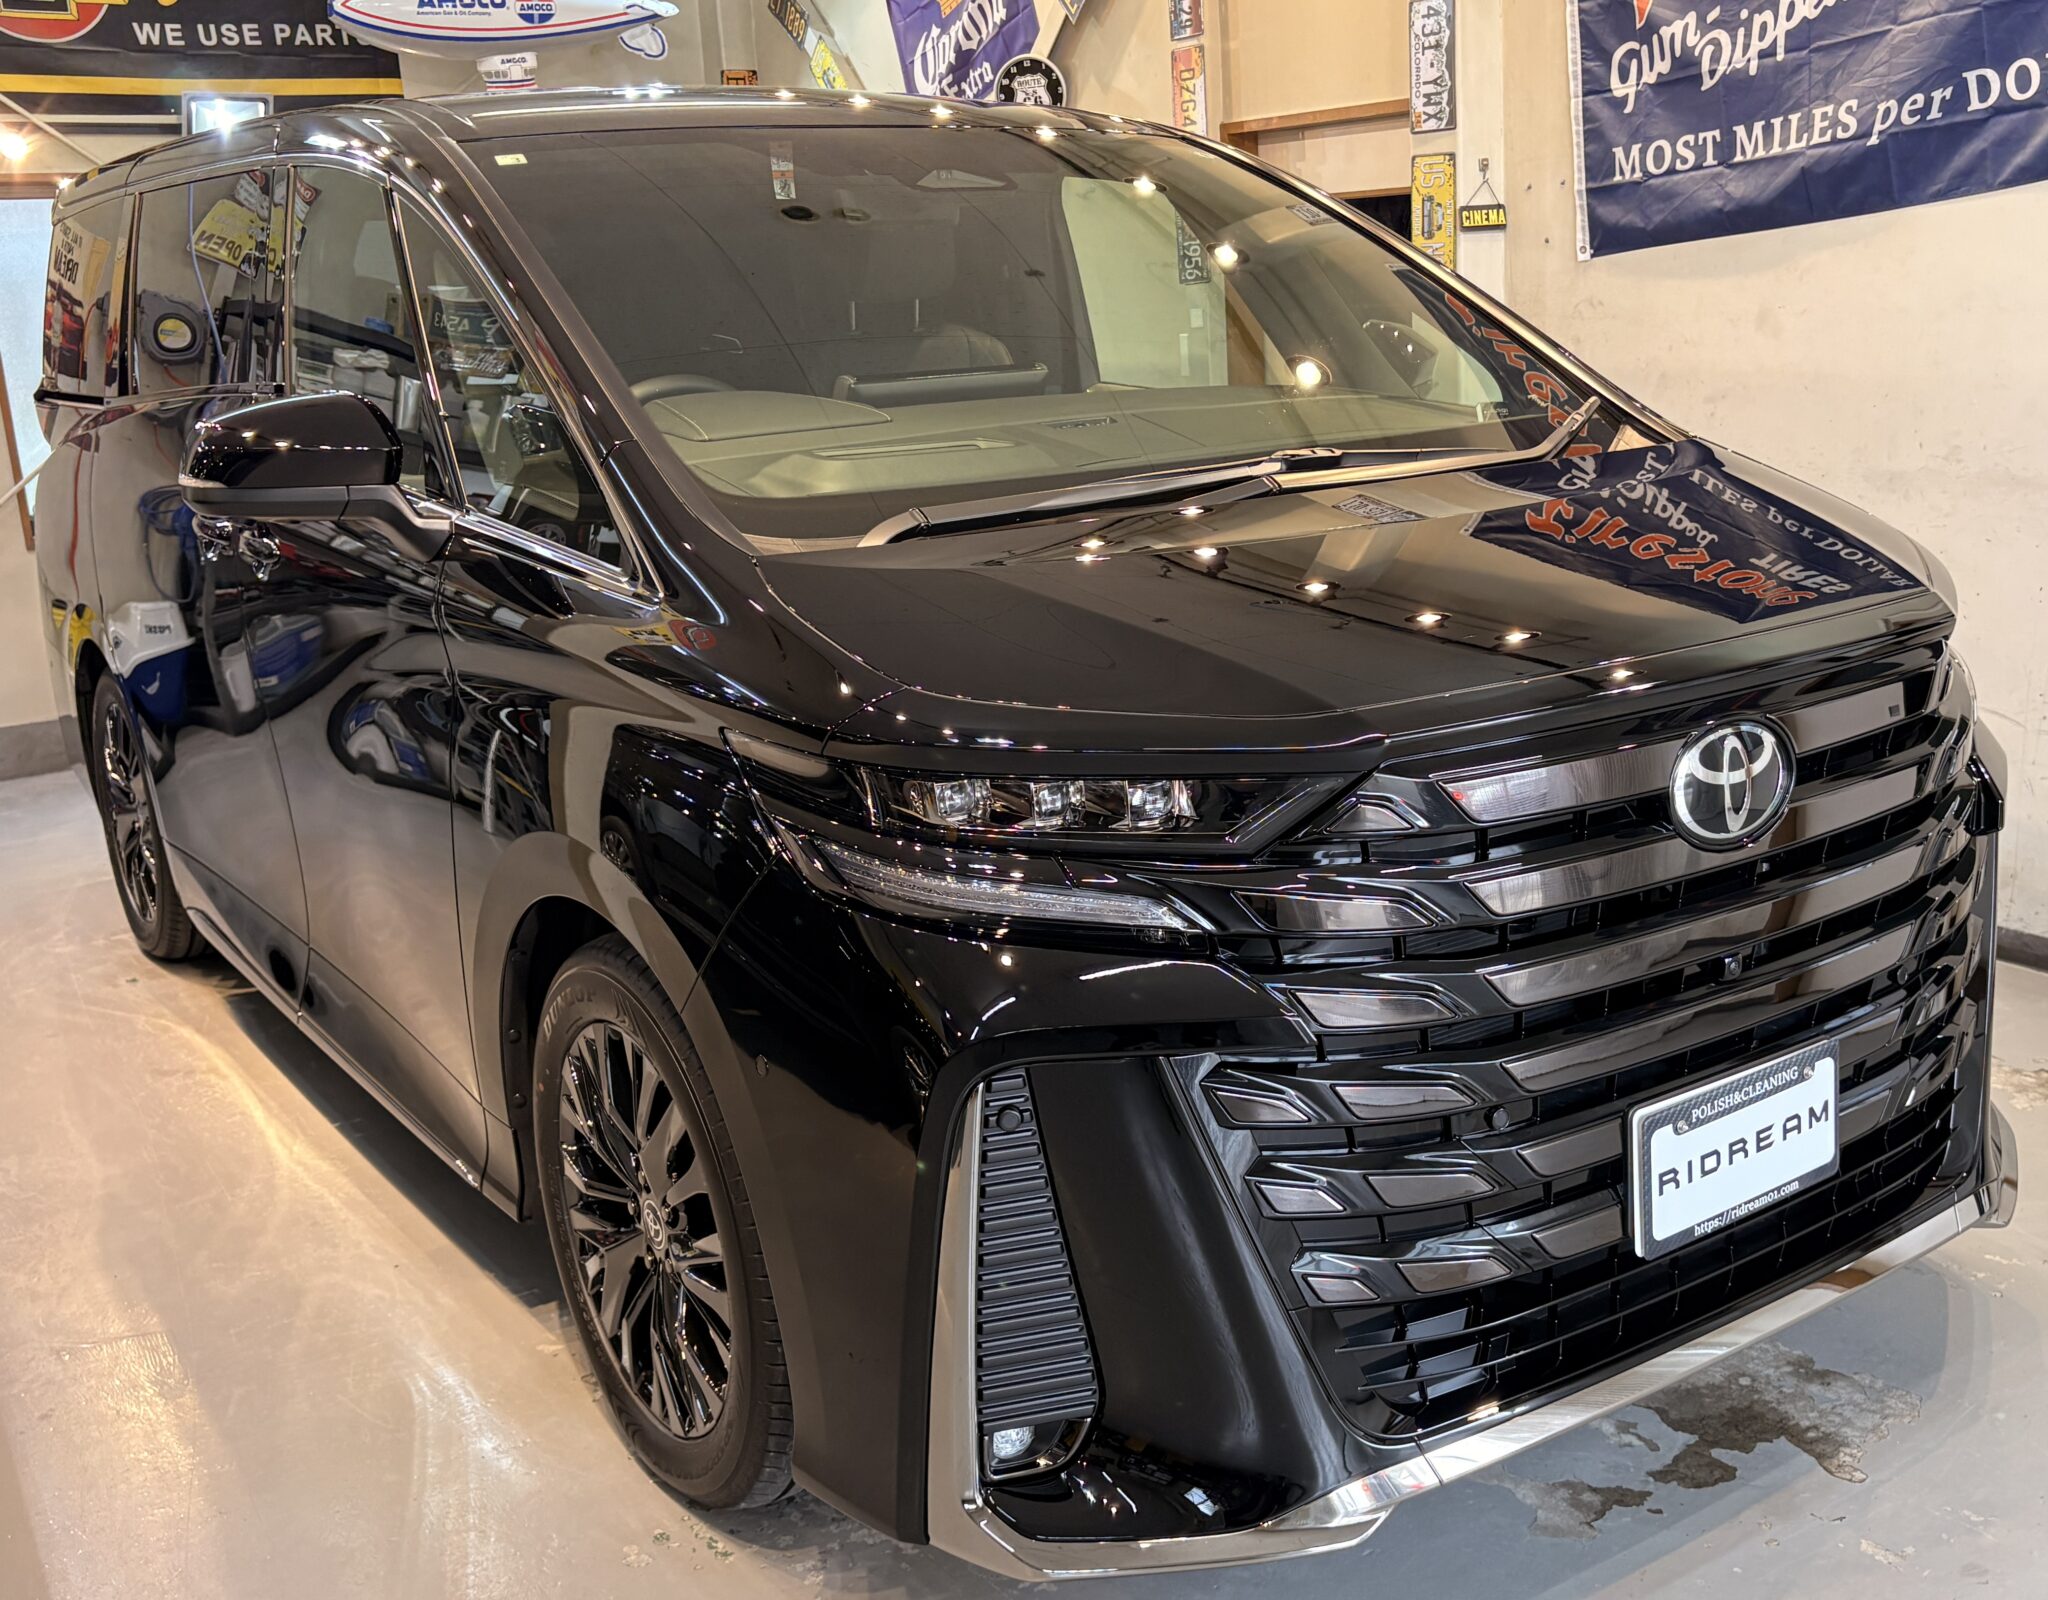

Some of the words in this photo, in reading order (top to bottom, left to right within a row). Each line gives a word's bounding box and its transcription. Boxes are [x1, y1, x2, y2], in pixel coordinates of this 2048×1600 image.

[132, 22, 186, 46] WE
[198, 23, 263, 46] USE
[274, 23, 371, 46] PART
[519, 3, 554, 12] AMOCO
[1413, 33, 1421, 99] COLORADO
[1695, 0, 1849, 91] Dippe
[1016, 77, 1042, 88] ROUTE
[1612, 129, 1720, 182] MOST
[1733, 99, 1859, 162] MILES
[1867, 85, 1953, 146] per
[1962, 53, 2048, 112] DO
[1462, 208, 1506, 226] CINEMA
[1691, 1066, 1799, 1123] POLISH&CLEANING
[1658, 1099, 1829, 1197] RIDREAM
[1694, 1180, 1800, 1236] https://ridream01.com
